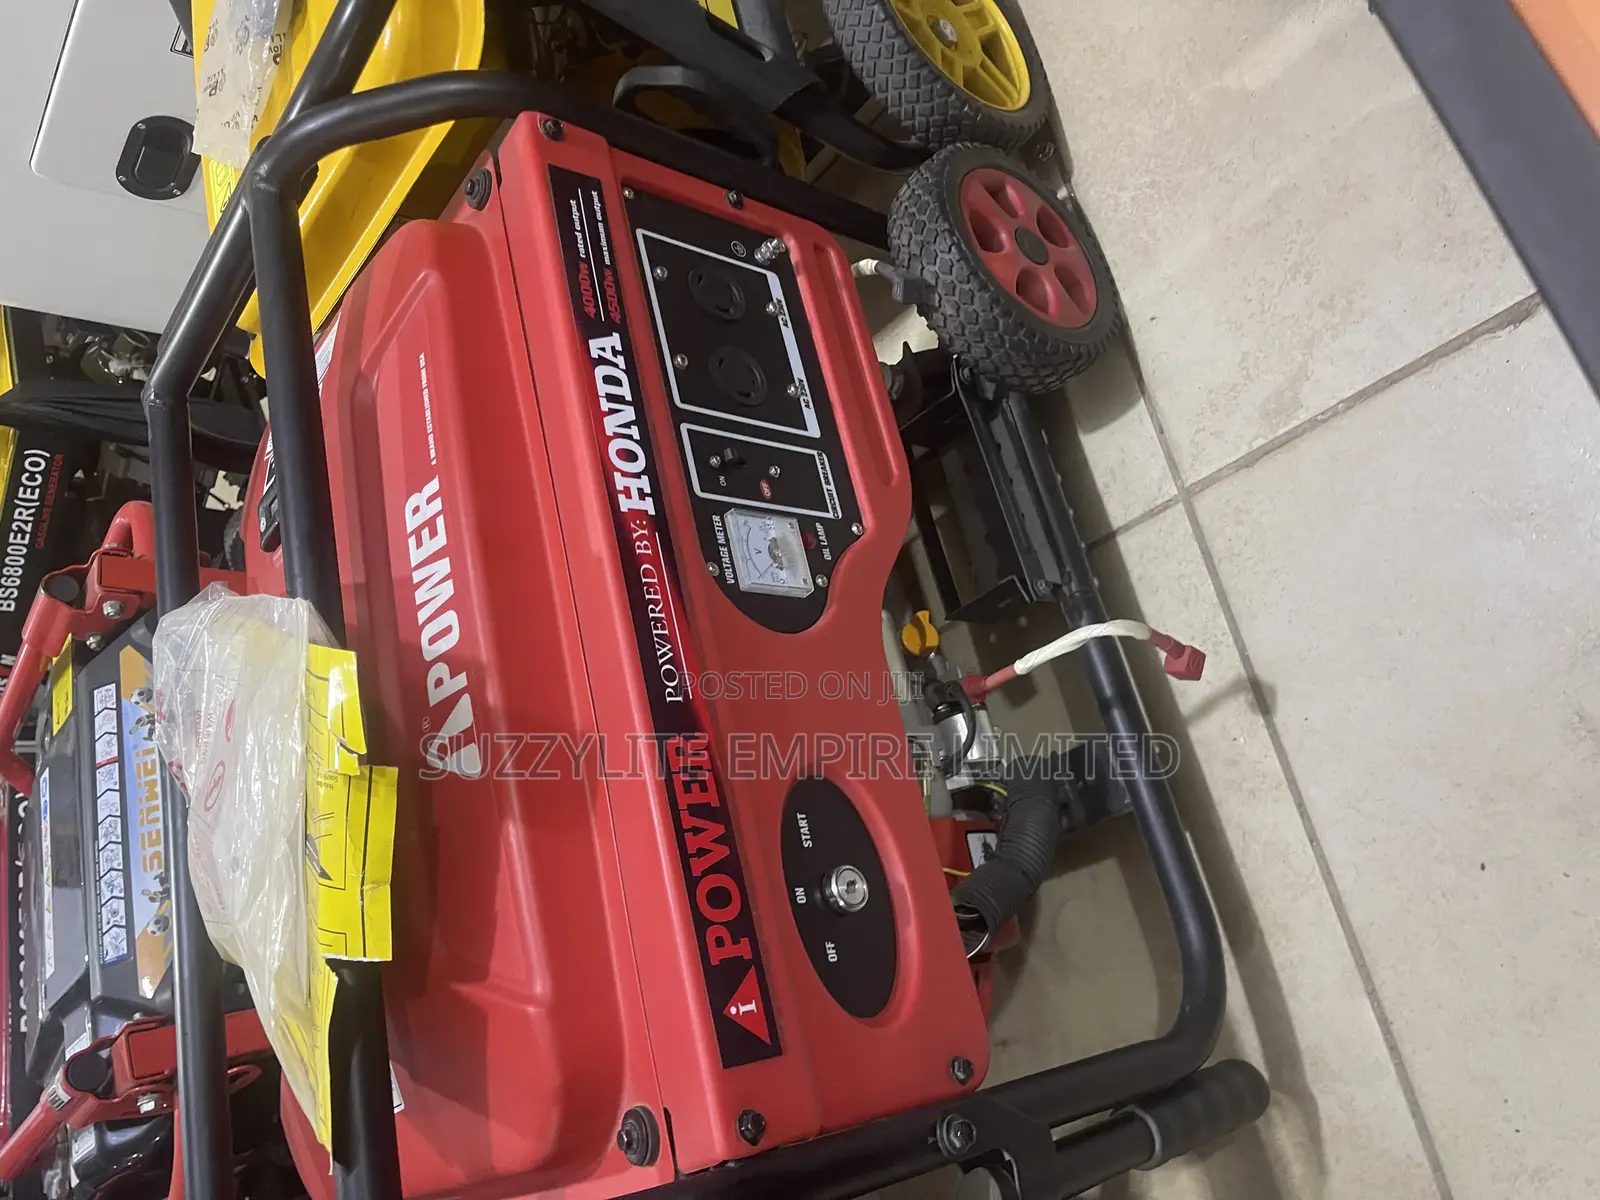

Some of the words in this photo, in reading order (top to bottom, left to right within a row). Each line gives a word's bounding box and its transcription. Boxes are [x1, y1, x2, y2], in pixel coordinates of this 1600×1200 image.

[570, 199, 581, 231] output
[592, 190, 603, 221] output
[574, 231, 586, 259] rated
[598, 222, 611, 265] maximum
[420, 367, 428, 389] FROM
[422, 387, 433, 434] ESTABLISHED
[588, 332, 656, 516] HONDA
[428, 433, 436, 459] BRAND
[44, 454, 64, 507] GENERATOR
[719, 476, 727, 487] ON
[817, 452, 831, 486] BREAKER
[762, 483, 771, 497] OFF
[826, 488, 840, 518] CIRCUIT
[0, 449, 50, 612] BS6800E2R(ECO)
[631, 519, 653, 555] BY:
[712, 515, 727, 544] METER
[815, 522, 828, 546] LAMP
[718, 545, 735, 584] VOLTAGE
[823, 548, 832, 561] OIL
[640, 563, 684, 704] POWERED
[135, 747, 164, 874] SENWEI
[796, 813, 813, 848] START
[795, 887, 807, 904] ON
[825, 941, 839, 963] OFF
